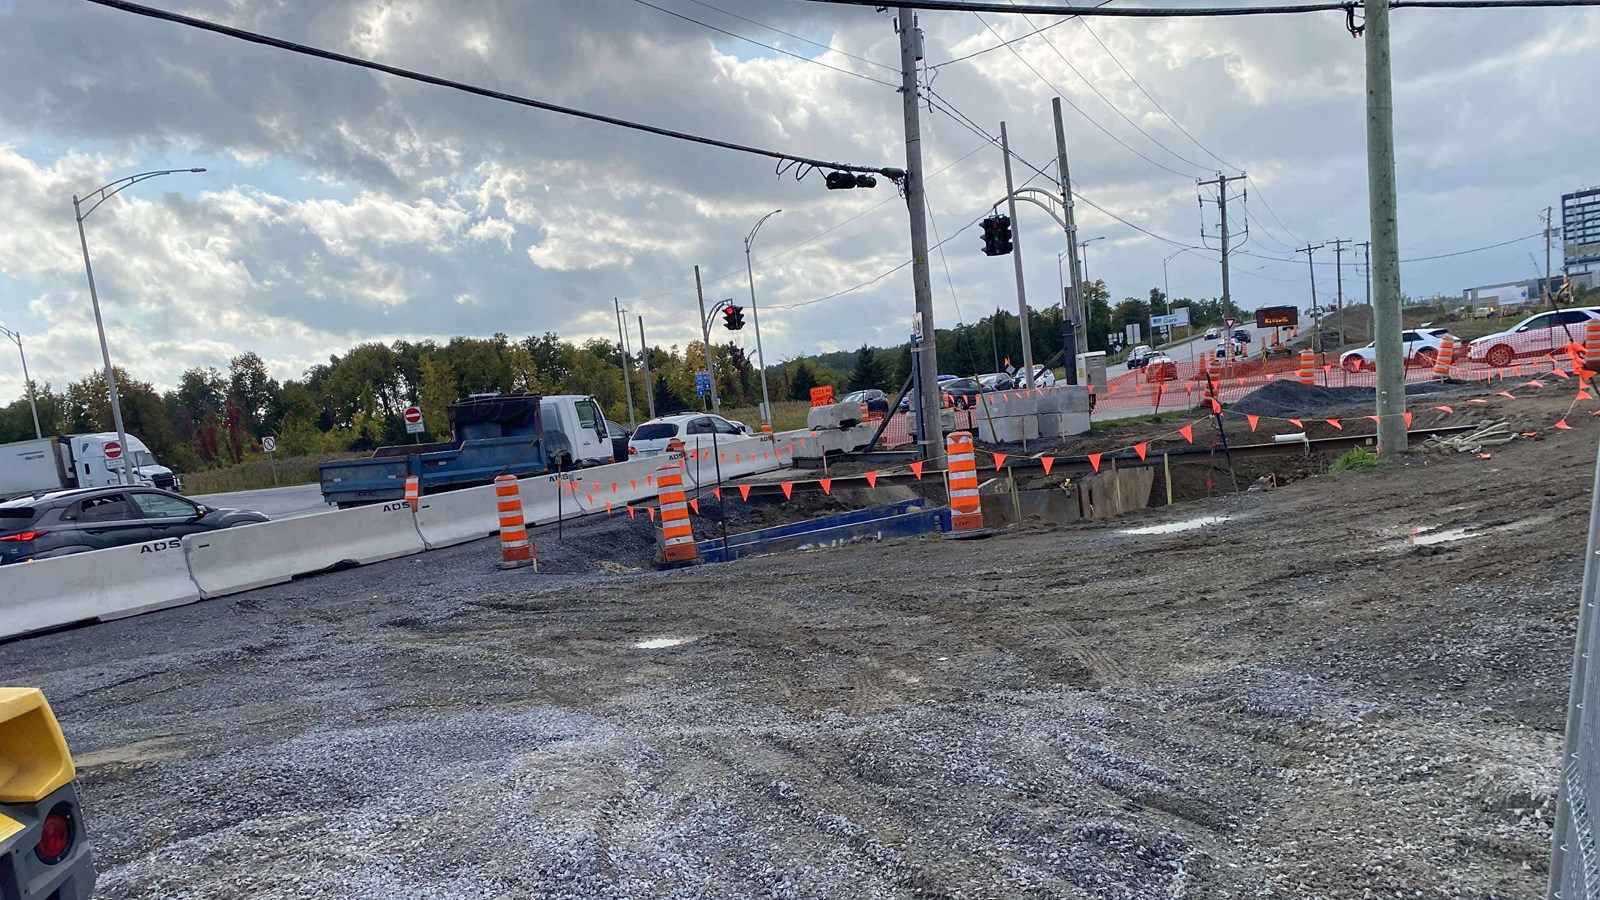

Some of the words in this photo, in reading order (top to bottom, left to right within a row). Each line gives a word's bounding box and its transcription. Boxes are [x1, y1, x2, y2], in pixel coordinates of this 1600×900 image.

[669, 453, 684, 461] ADS
[383, 501, 410, 512] ADS
[141, 540, 181, 554] ADS
